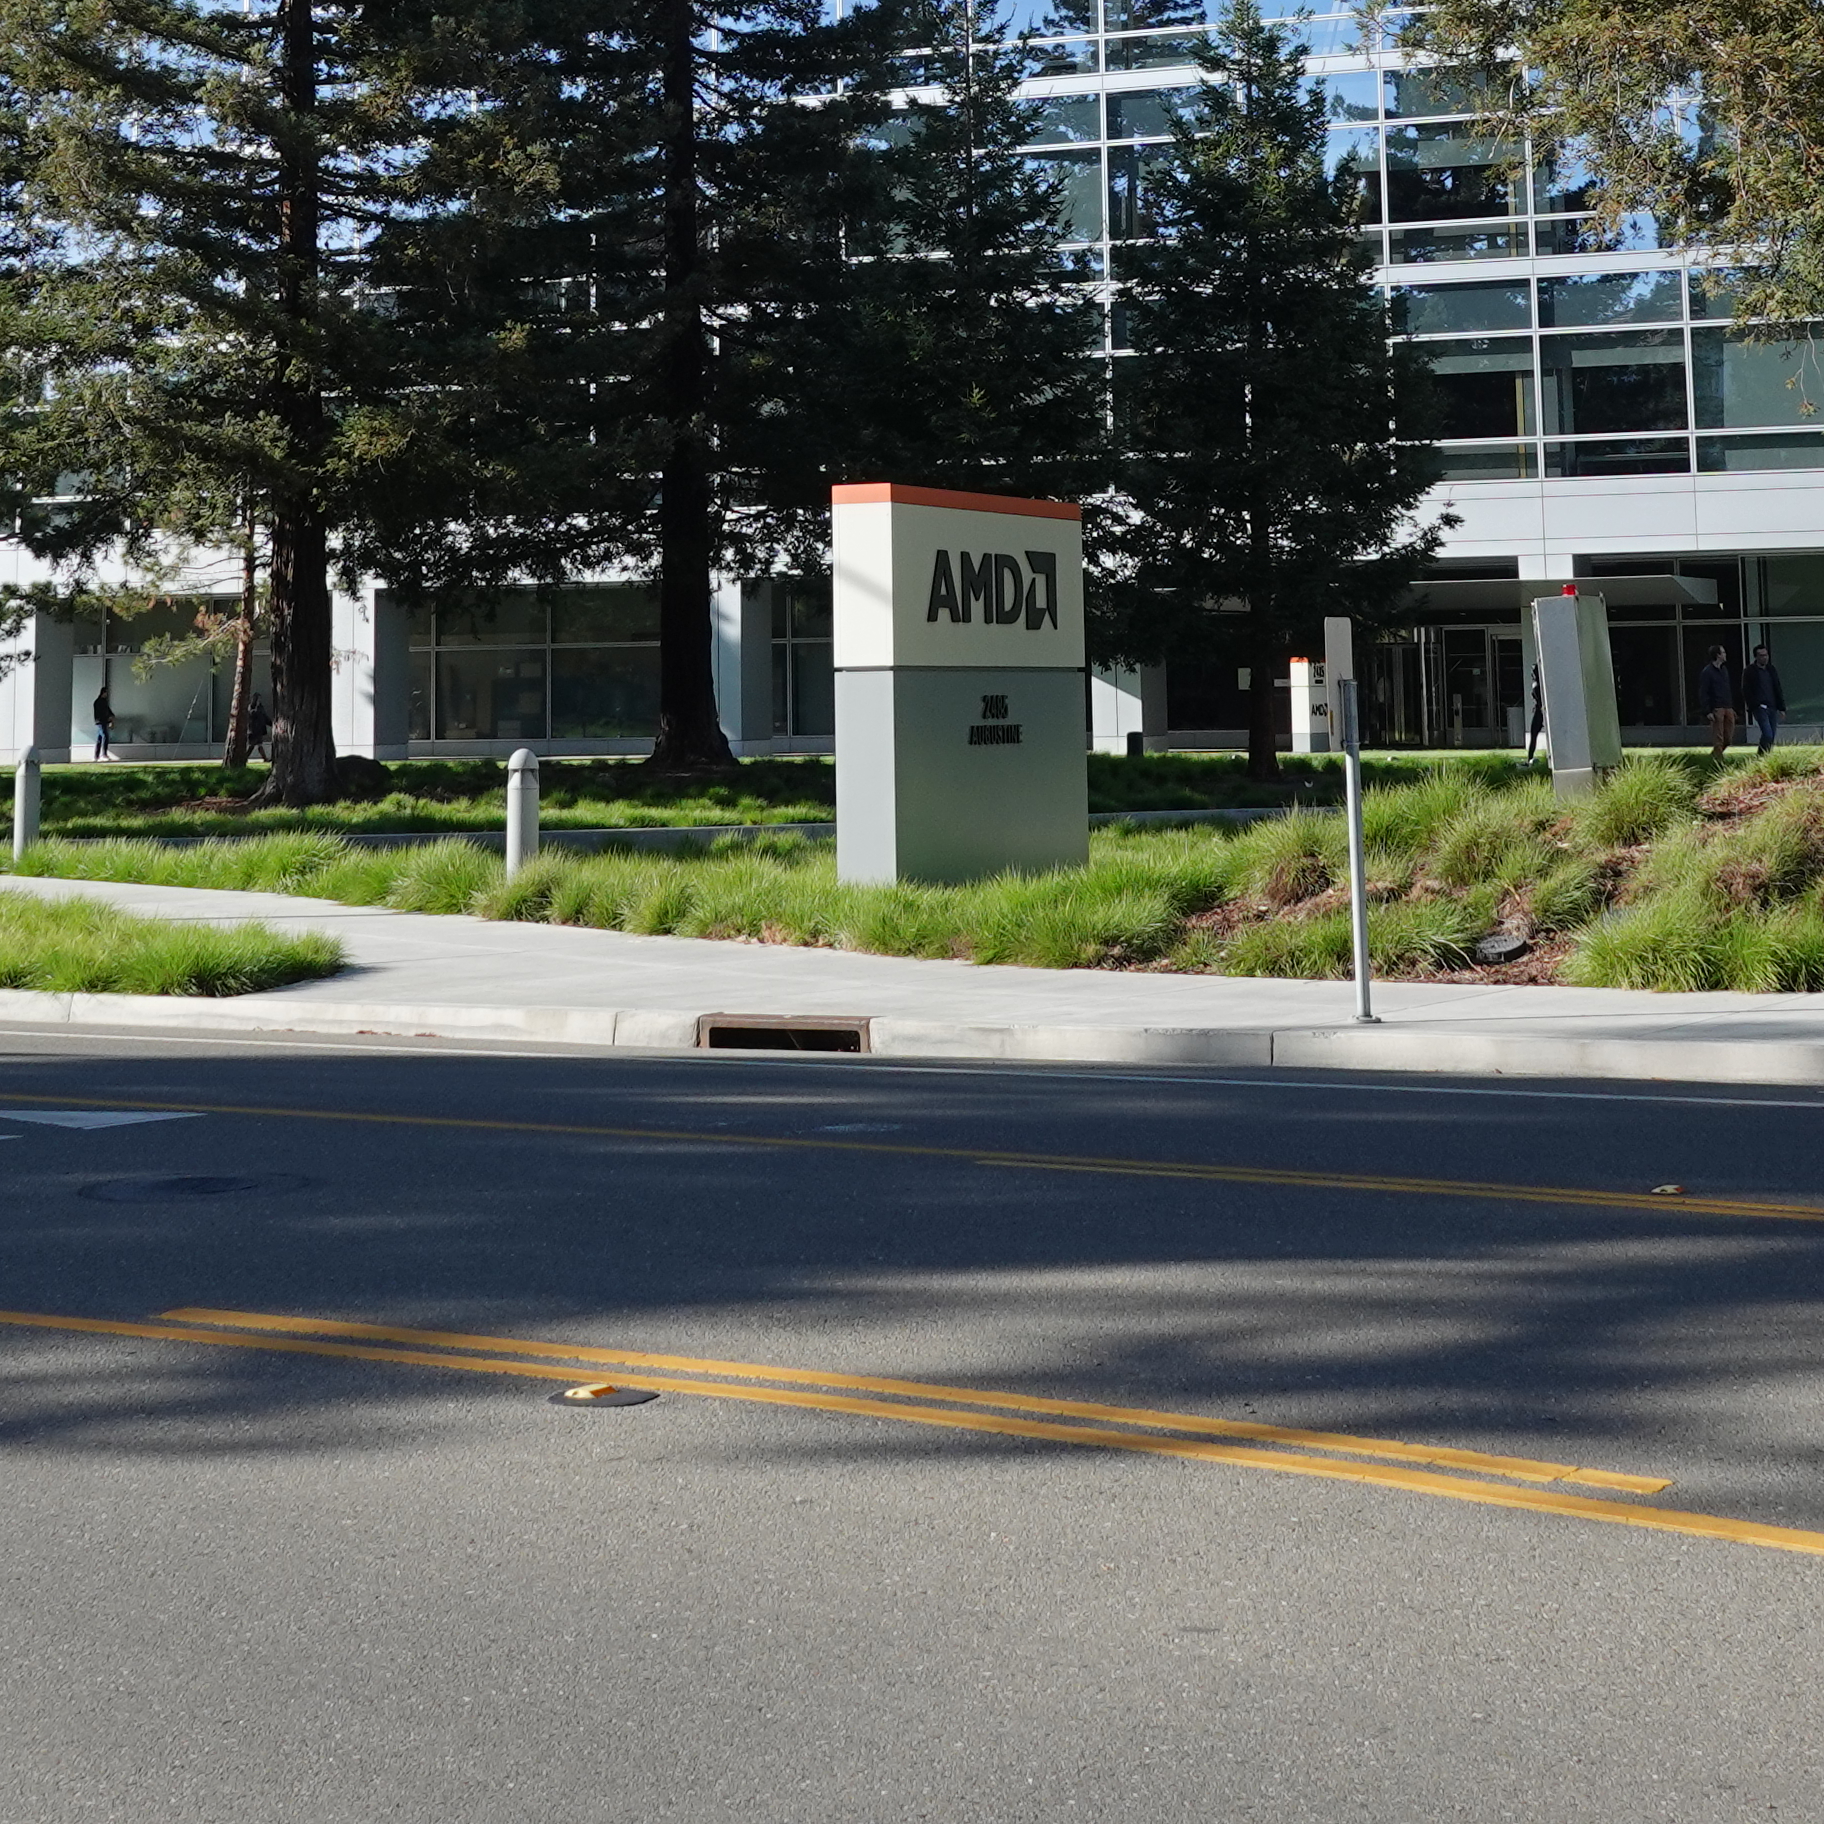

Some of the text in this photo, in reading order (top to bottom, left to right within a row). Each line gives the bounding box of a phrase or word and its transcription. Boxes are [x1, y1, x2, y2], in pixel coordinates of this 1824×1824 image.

[927, 549, 1024, 624] AMD
[980, 694, 1009, 719] 2485
[967, 724, 1023, 745] AUGUSTINE
